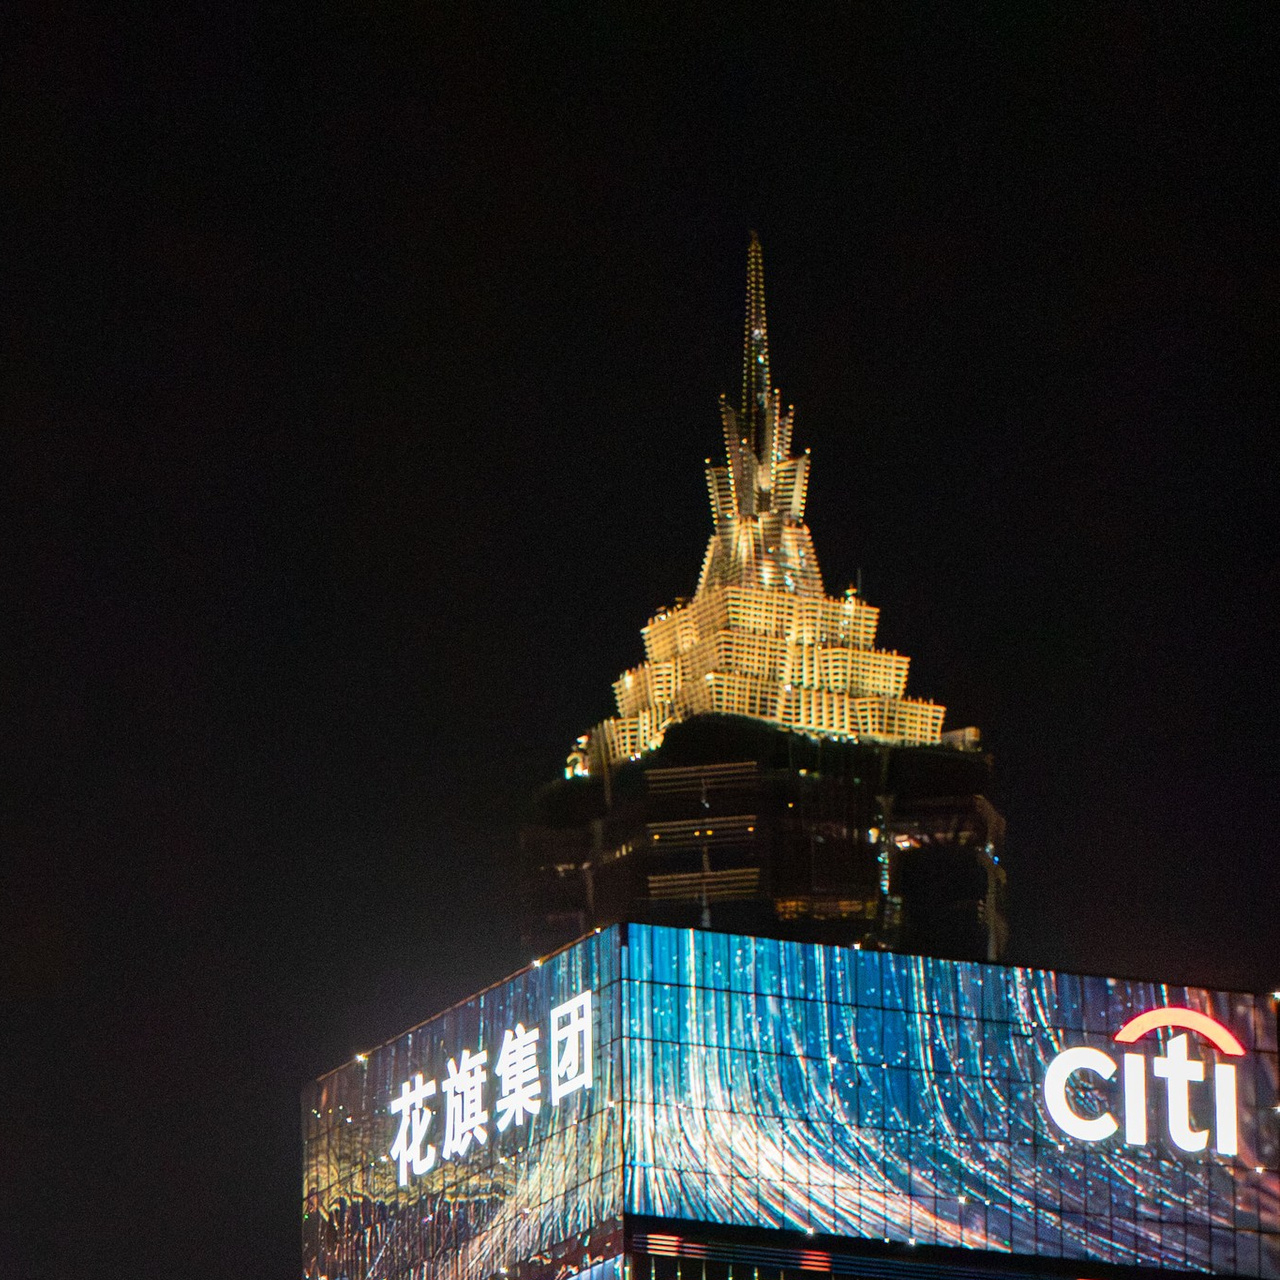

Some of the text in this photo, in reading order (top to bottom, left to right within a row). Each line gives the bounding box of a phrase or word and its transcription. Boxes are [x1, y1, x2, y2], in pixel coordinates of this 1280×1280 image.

[389, 989, 593, 1187] 花旗集团
[1043, 1010, 1244, 1156] citi
